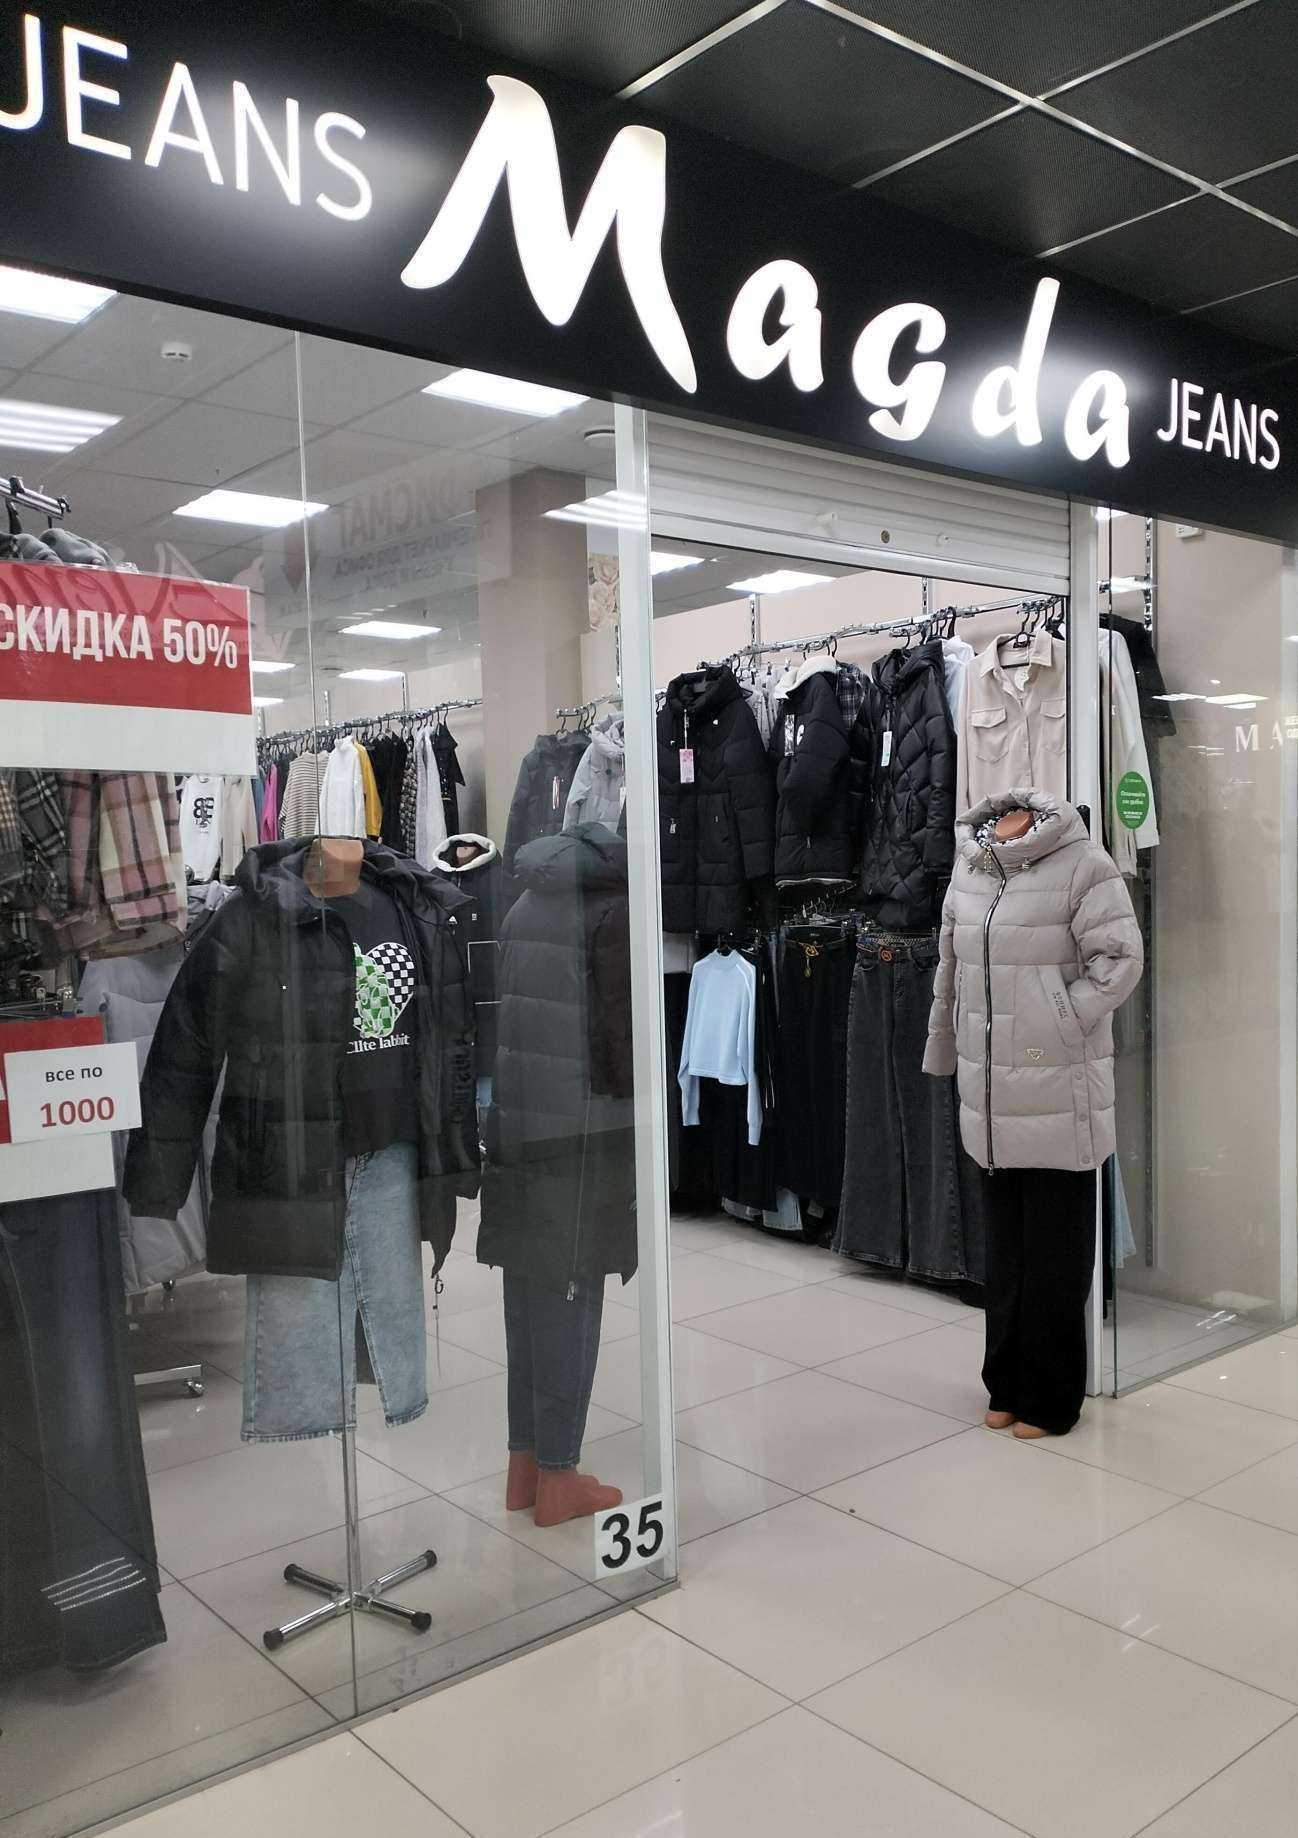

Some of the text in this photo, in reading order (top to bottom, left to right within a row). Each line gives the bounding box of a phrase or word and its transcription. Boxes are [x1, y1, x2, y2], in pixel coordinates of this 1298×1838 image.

[0, 13, 1281, 470] JEANS Magda JEANS
[0, 603, 238, 669] СКИДКА 50%
[45, 1066, 103, 1082] все по
[40, 1096, 115, 1128] 1000
[601, 1500, 664, 1569] 35
